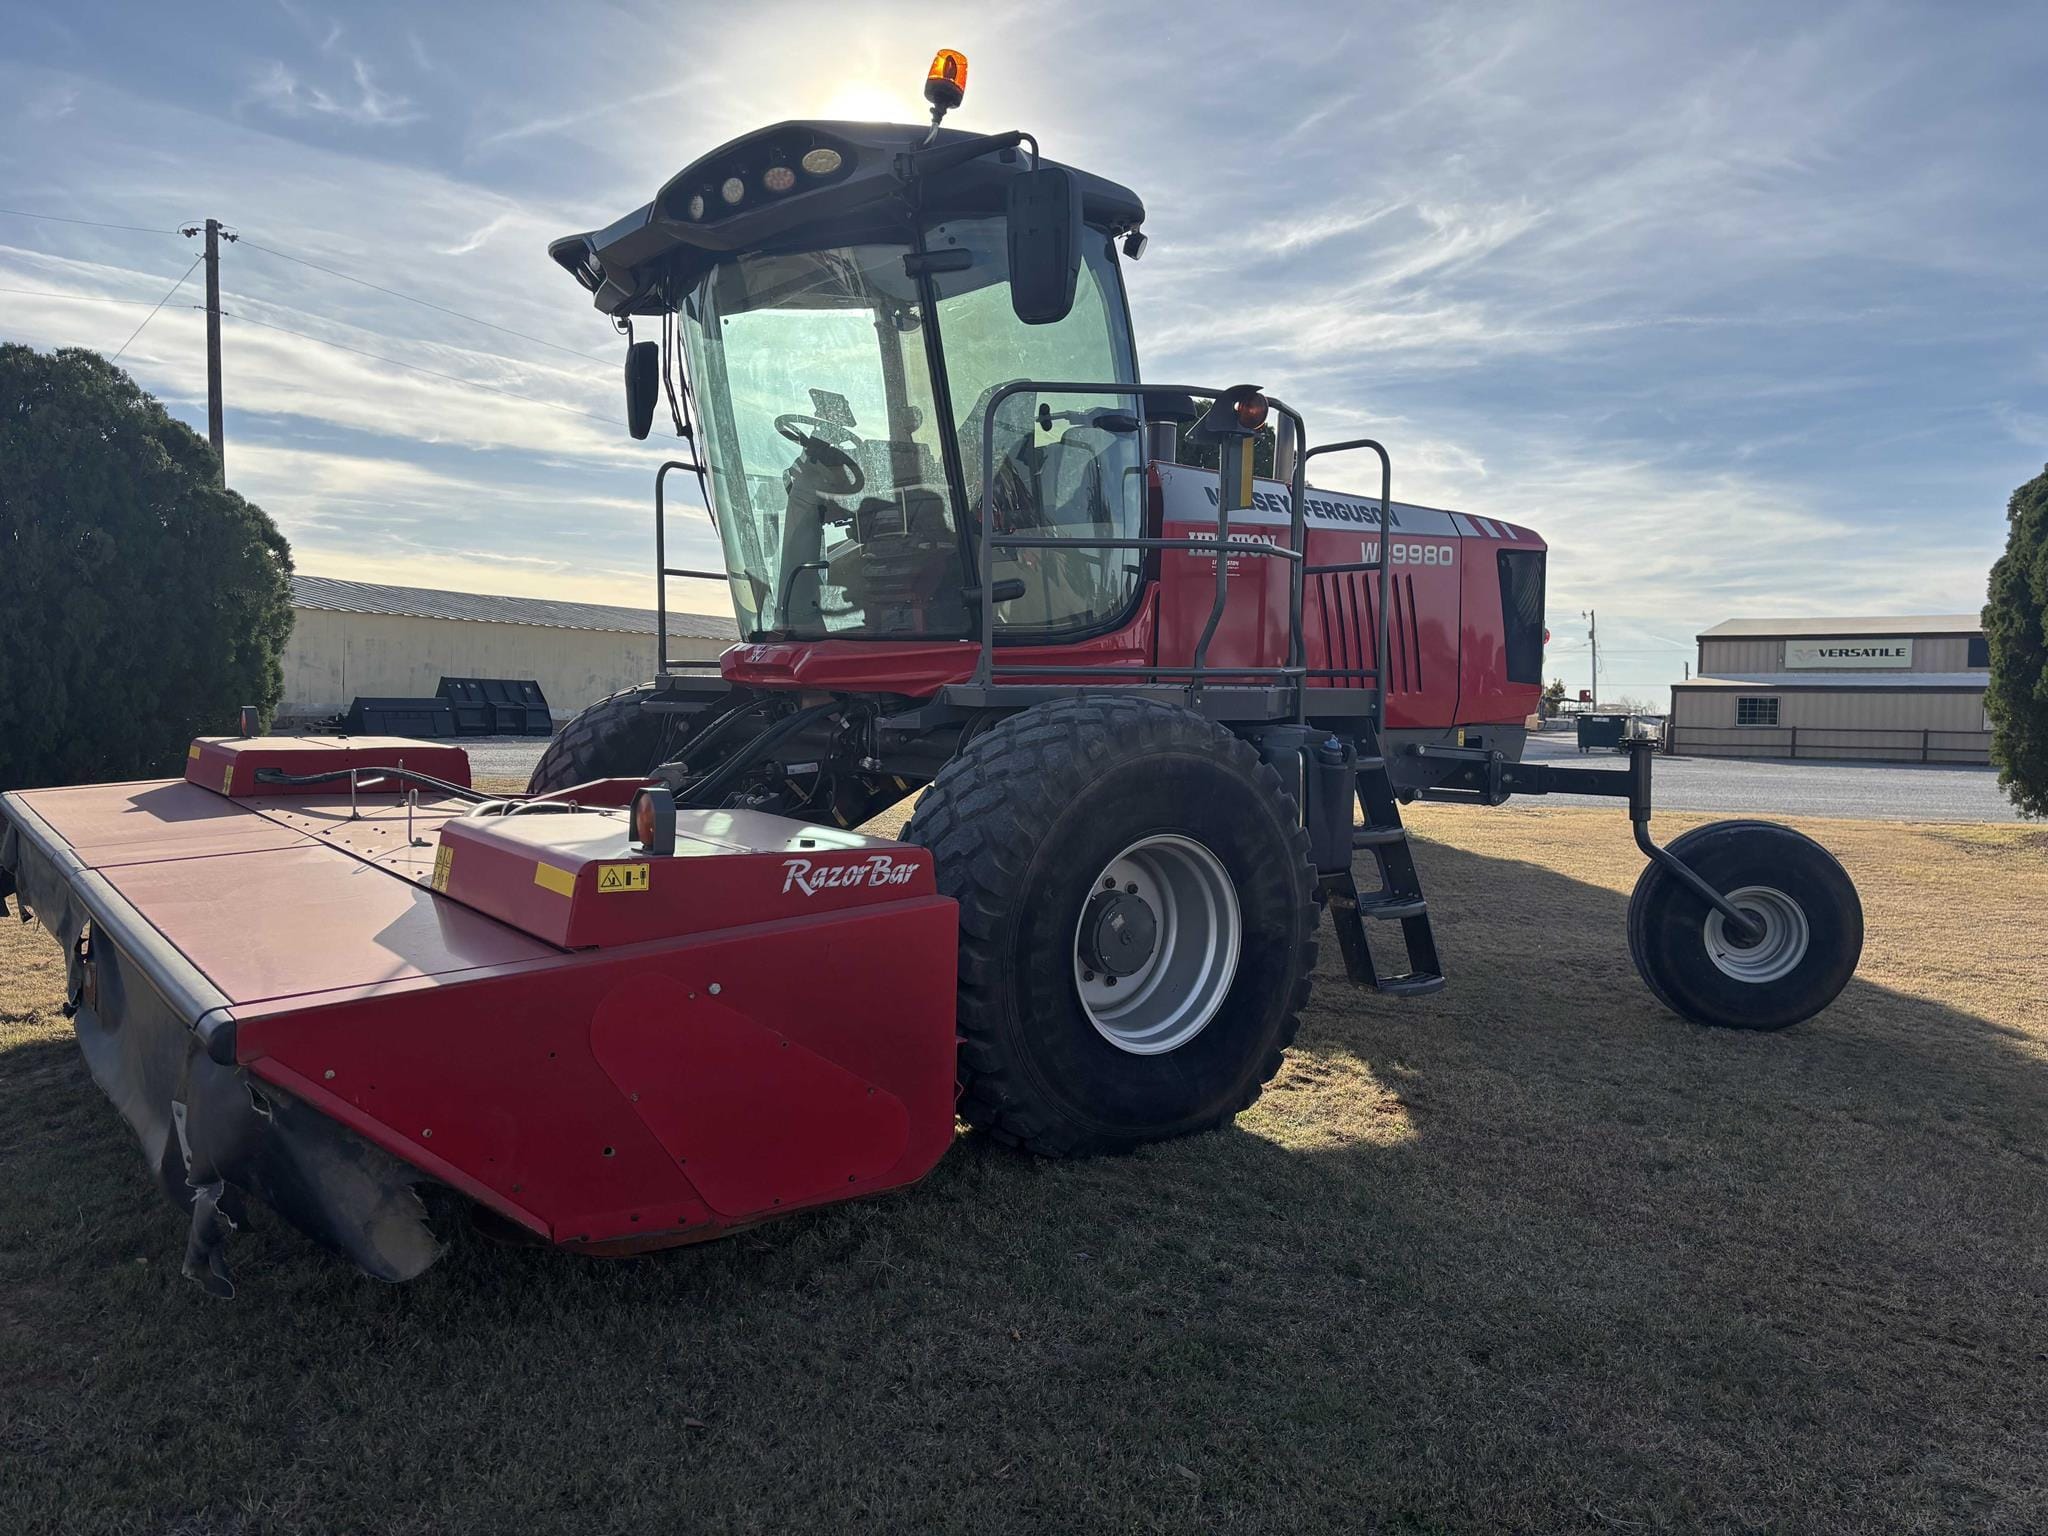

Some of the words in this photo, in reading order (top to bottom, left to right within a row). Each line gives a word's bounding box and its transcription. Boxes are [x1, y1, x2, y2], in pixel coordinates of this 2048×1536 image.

[1203, 486, 1293, 513] MSEY
[1188, 532, 1277, 557] HESTON
[1361, 541, 1453, 566] W9980
[1818, 647, 1906, 657] VERSATILE
